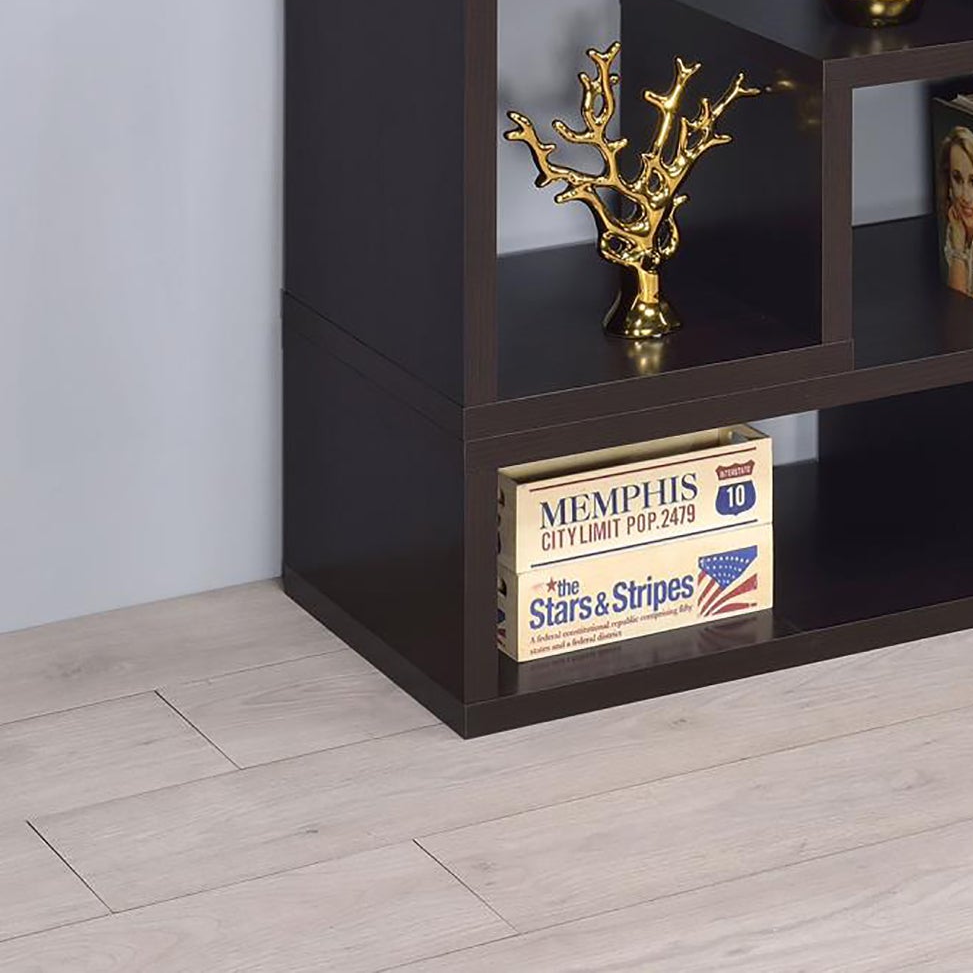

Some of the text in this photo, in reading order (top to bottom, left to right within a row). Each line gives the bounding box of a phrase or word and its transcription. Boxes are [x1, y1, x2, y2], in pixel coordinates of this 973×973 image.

[540, 473, 698, 529] MEMPHIS
[726, 484, 745, 507] 10
[542, 526, 577, 551] CITY
[579, 518, 621, 544] LIMIT
[529, 574, 694, 630] Stars & Stripes
[557, 578, 579, 597] the
[530, 645, 551, 654] states
[551, 640, 566, 651] and
[571, 635, 596, 647] federal
[597, 629, 622, 642] district
[536, 630, 562, 643] federal
[562, 621, 610, 638] constitutional
[611, 614, 638, 629] republic
[640, 607, 678, 623] comprising
